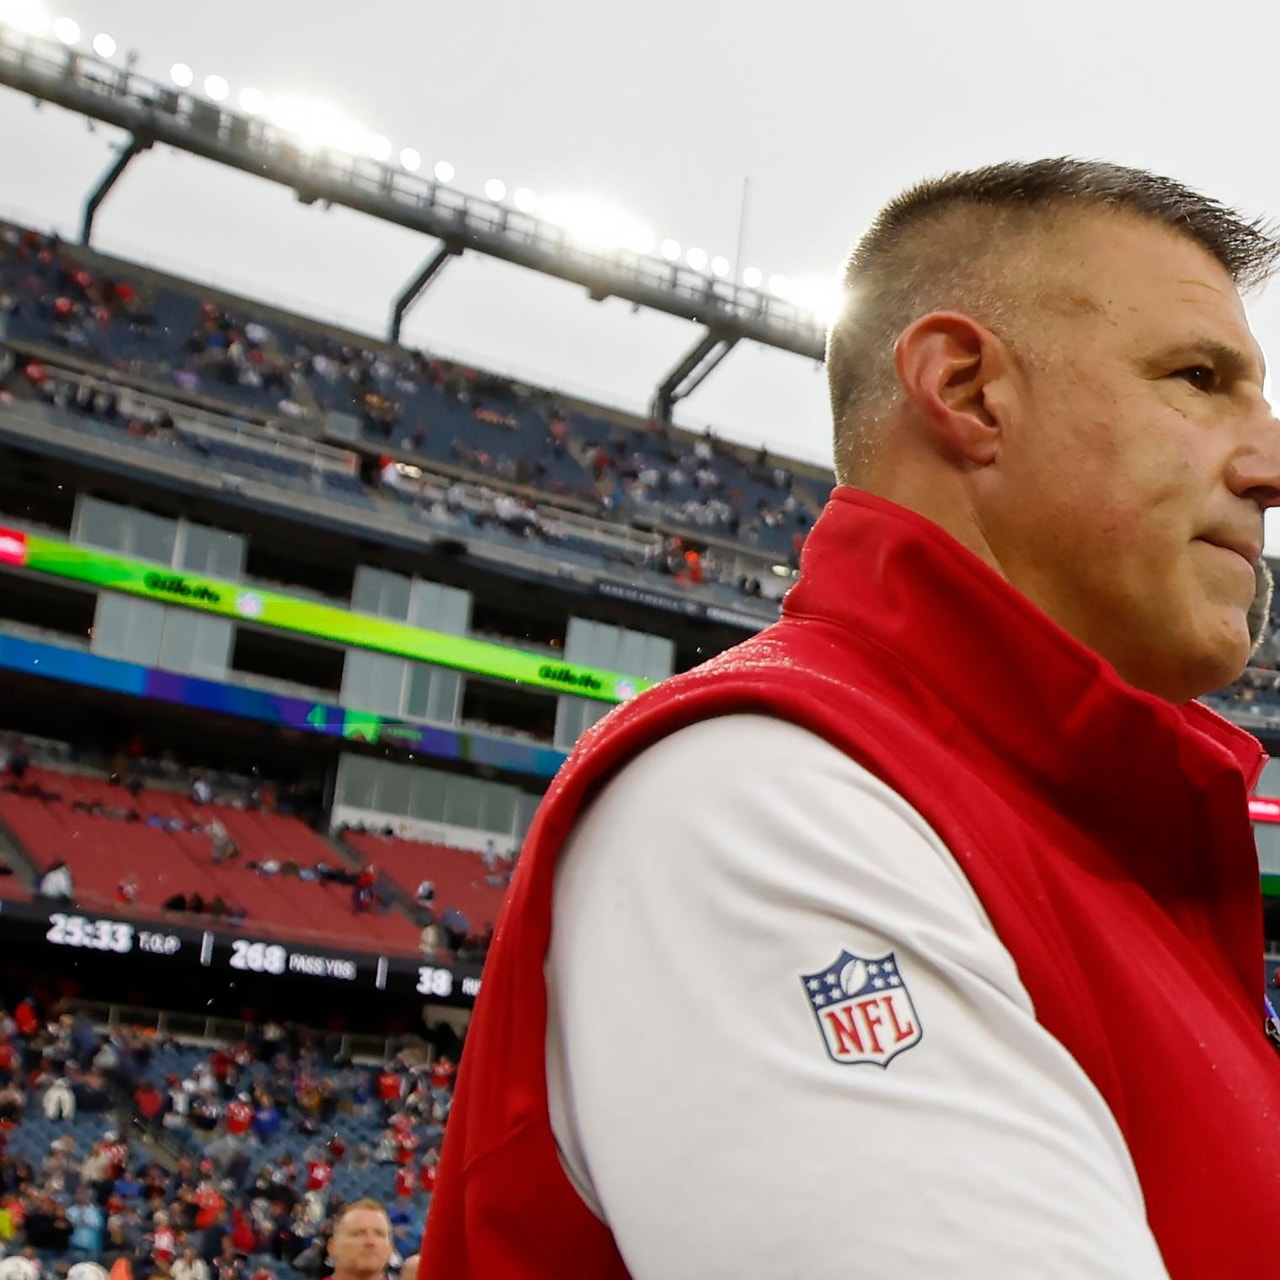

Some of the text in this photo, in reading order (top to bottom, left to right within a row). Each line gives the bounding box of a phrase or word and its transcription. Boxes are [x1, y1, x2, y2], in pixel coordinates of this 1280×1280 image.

[45, 913, 134, 954] 25:33
[229, 938, 288, 975] 268
[289, 952, 324, 974] PASS
[415, 965, 454, 998] 38
[823, 995, 915, 1055] NFL
